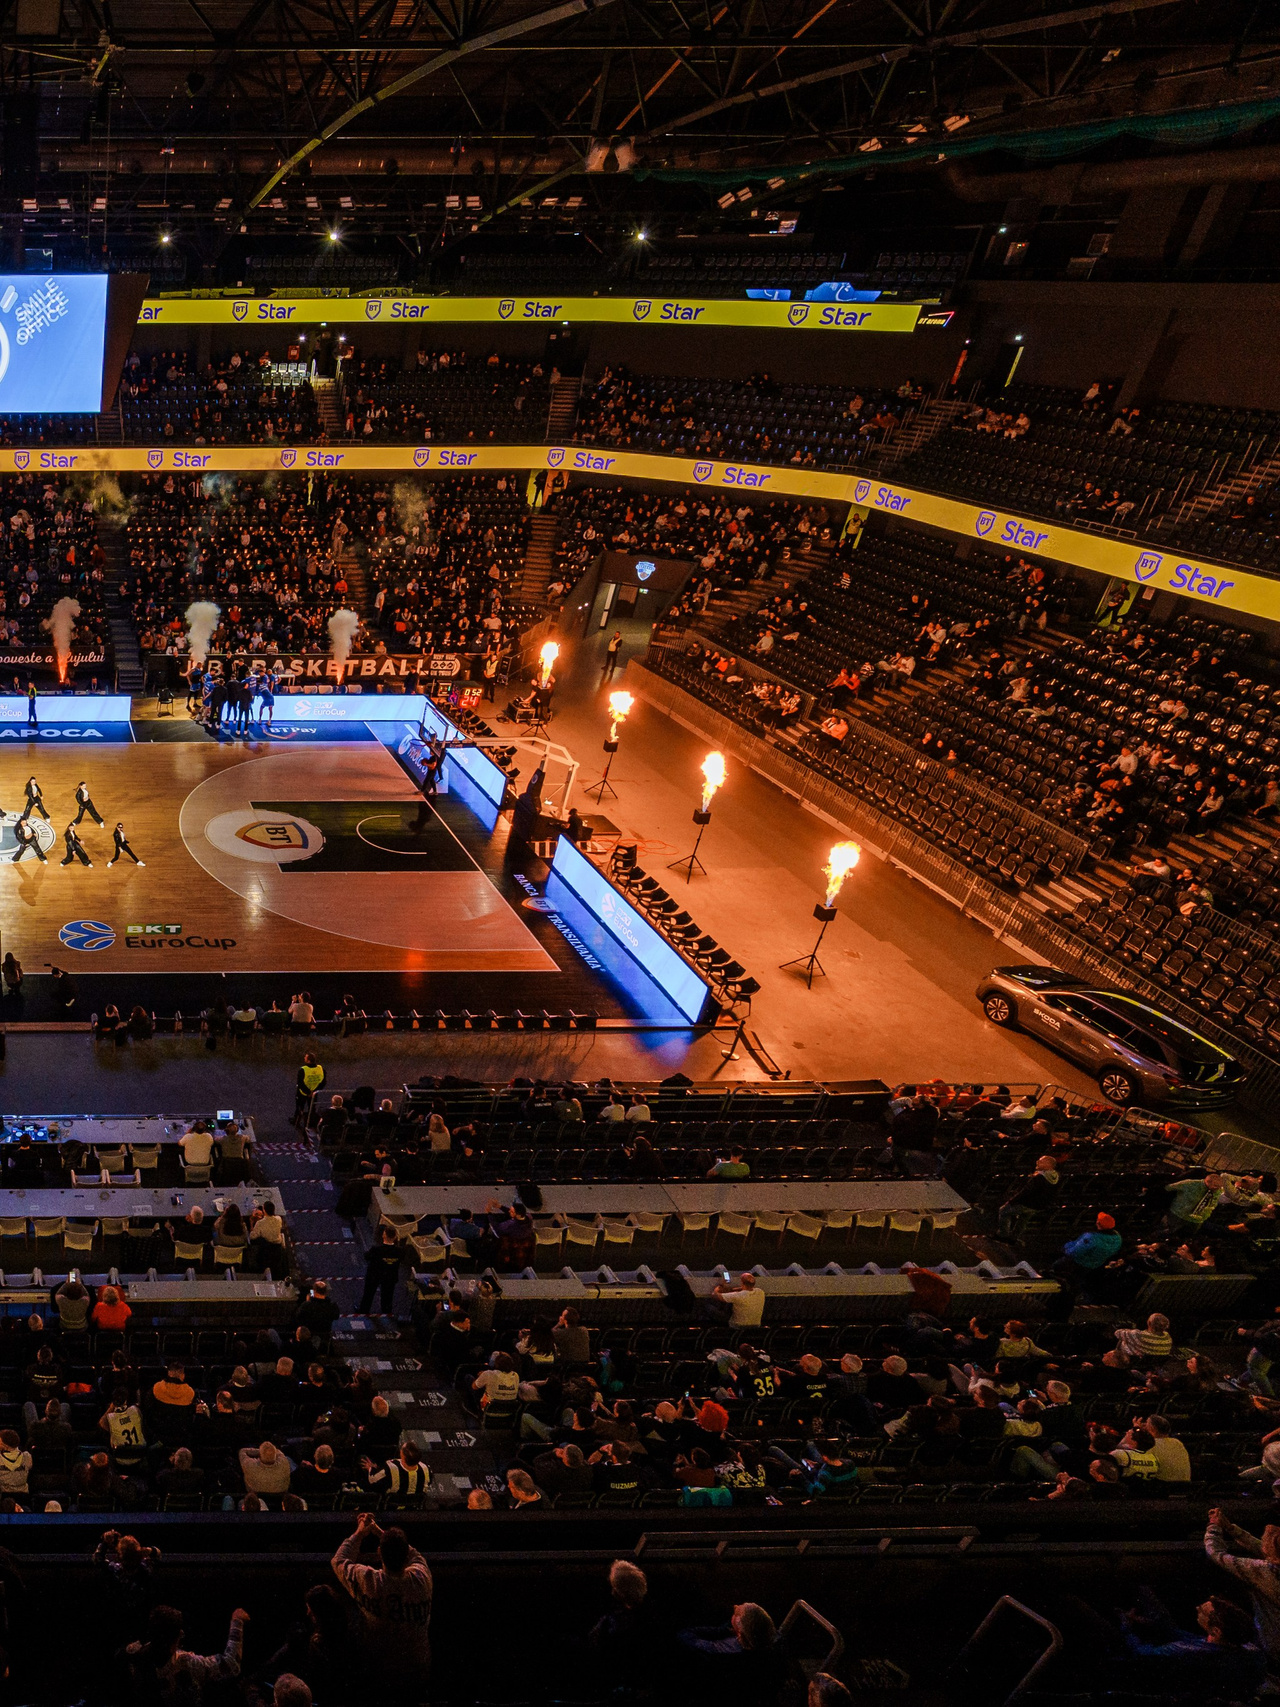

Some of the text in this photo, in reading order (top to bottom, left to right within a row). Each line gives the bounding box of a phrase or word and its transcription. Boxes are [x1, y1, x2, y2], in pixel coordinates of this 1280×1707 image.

[258, 304, 296, 319] Star
[391, 303, 429, 318] Star
[523, 302, 562, 317] Star
[660, 303, 704, 320] Star
[819, 307, 872, 326] Star
[40, 453, 78, 468] Star
[173, 452, 212, 467] Star
[306, 451, 345, 466] Star
[438, 451, 477, 466] Star
[574, 452, 616, 470] Star
[697, 457, 771, 486] BT Star
[858, 485, 912, 511] BT Star
[980, 517, 1049, 548] BT Star
[1141, 558, 1235, 598] BT Star
[45, 655, 54, 663] a
[461, 697, 478, 706] 24
[313, 708, 346, 717] EuroCup
[265, 826, 292, 843] BT
[513, 874, 539, 897] BANCA
[127, 925, 181, 934] BKT
[614, 915, 639, 948] EuroCup
[125, 936, 237, 951] EuroCup
[753, 1376, 774, 1397] 35
[806, 1383, 827, 1391] GUZMAN
[122, 1427, 139, 1447] 31
[610, 1481, 638, 1489] GUZMAN
